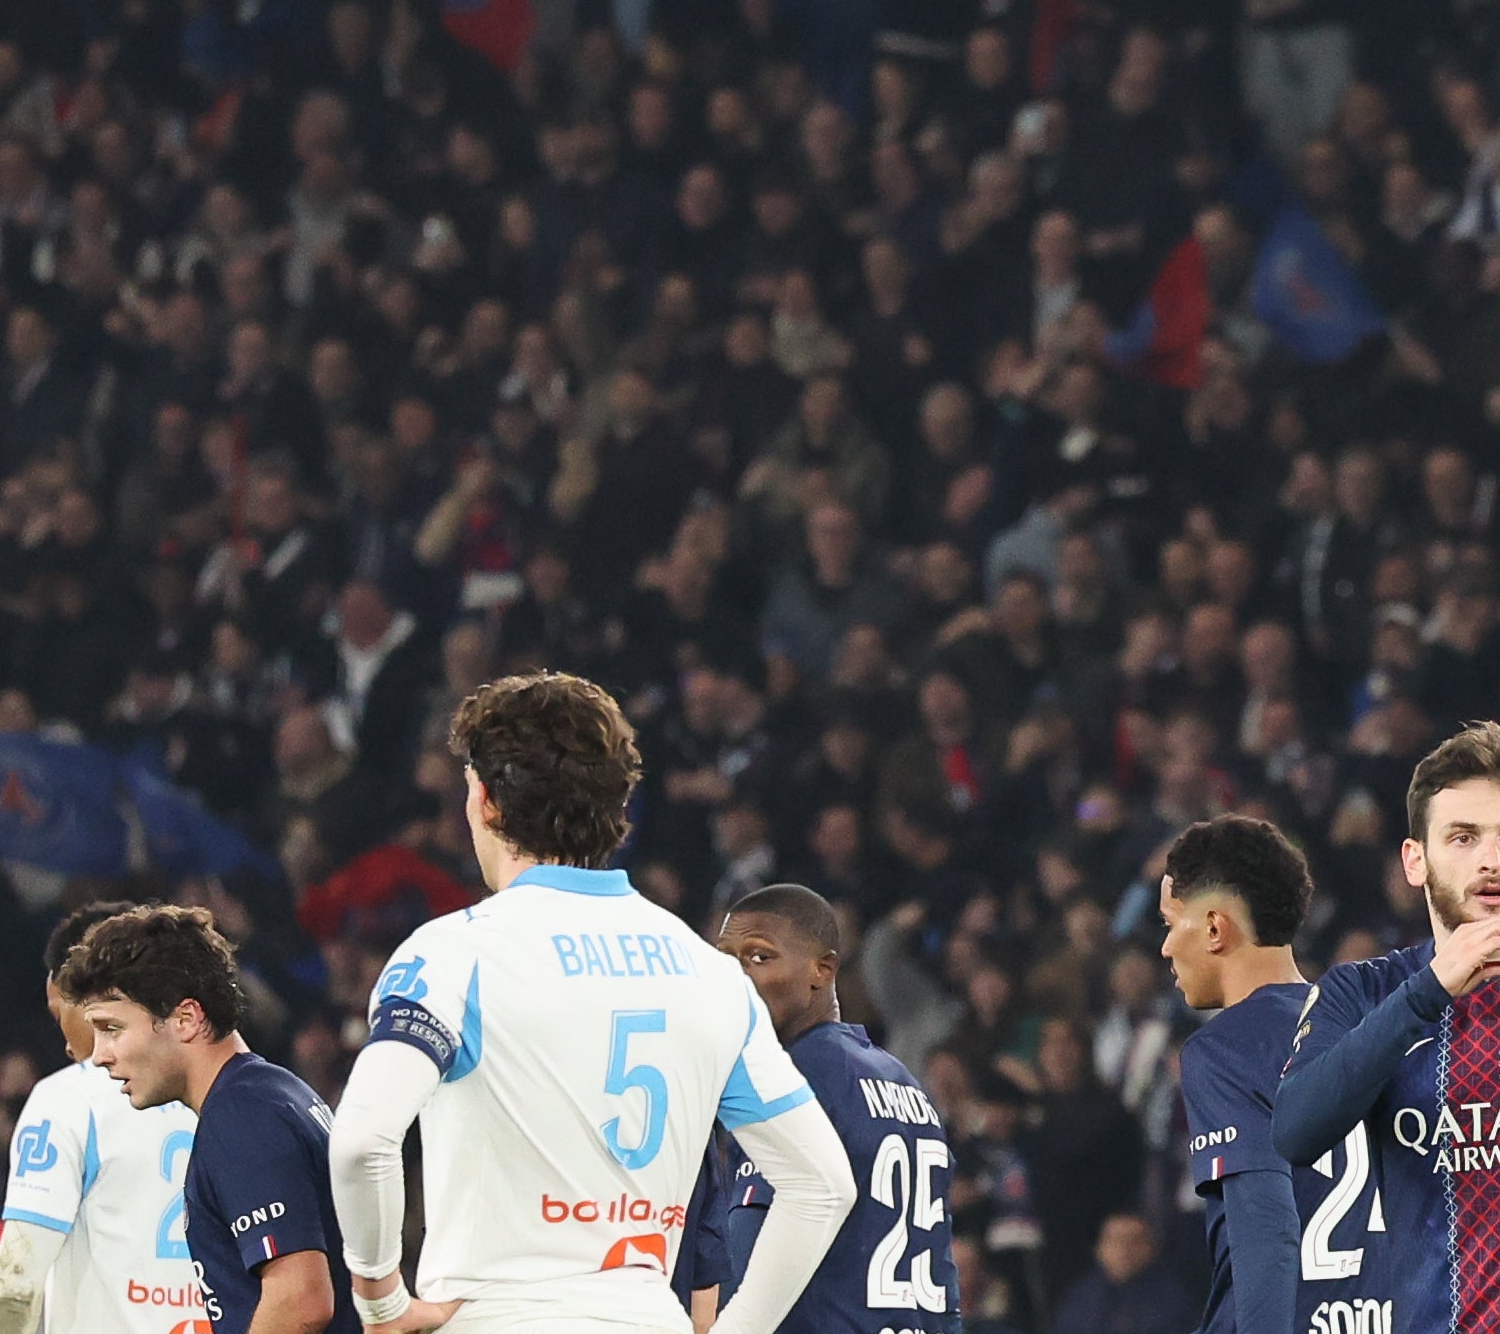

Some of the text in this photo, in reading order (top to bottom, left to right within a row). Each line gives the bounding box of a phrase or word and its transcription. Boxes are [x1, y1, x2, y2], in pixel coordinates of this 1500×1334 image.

[390, 1008, 411, 1017] NO
[600, 1009, 668, 1171] 5
[866, 1133, 949, 1313] 25
